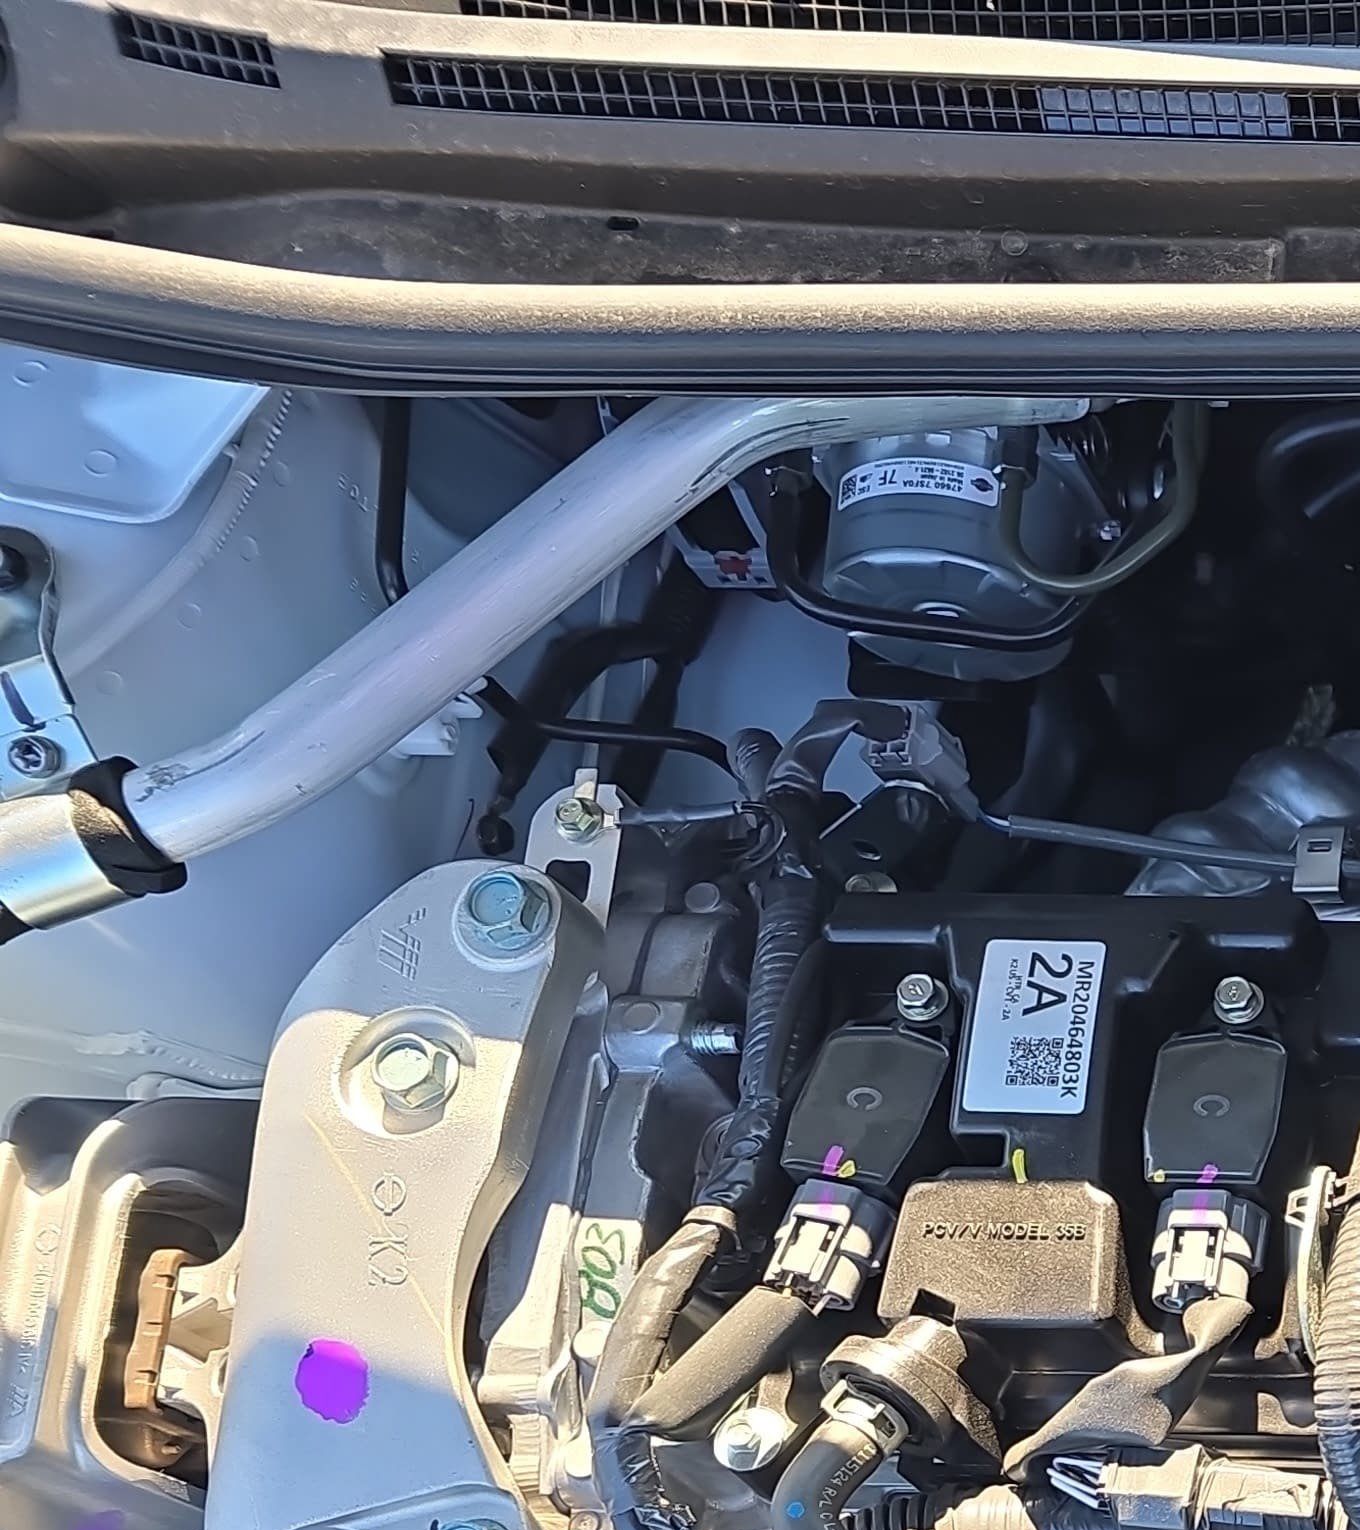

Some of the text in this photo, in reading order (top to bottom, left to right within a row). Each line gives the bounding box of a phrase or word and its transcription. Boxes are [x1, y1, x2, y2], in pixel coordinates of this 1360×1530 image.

[878, 469, 897, 487] 7F
[1022, 951, 1074, 1018] 2A
[1060, 961, 1095, 1099] MR20464803K
[986, 1221, 1050, 1241] MODEL
